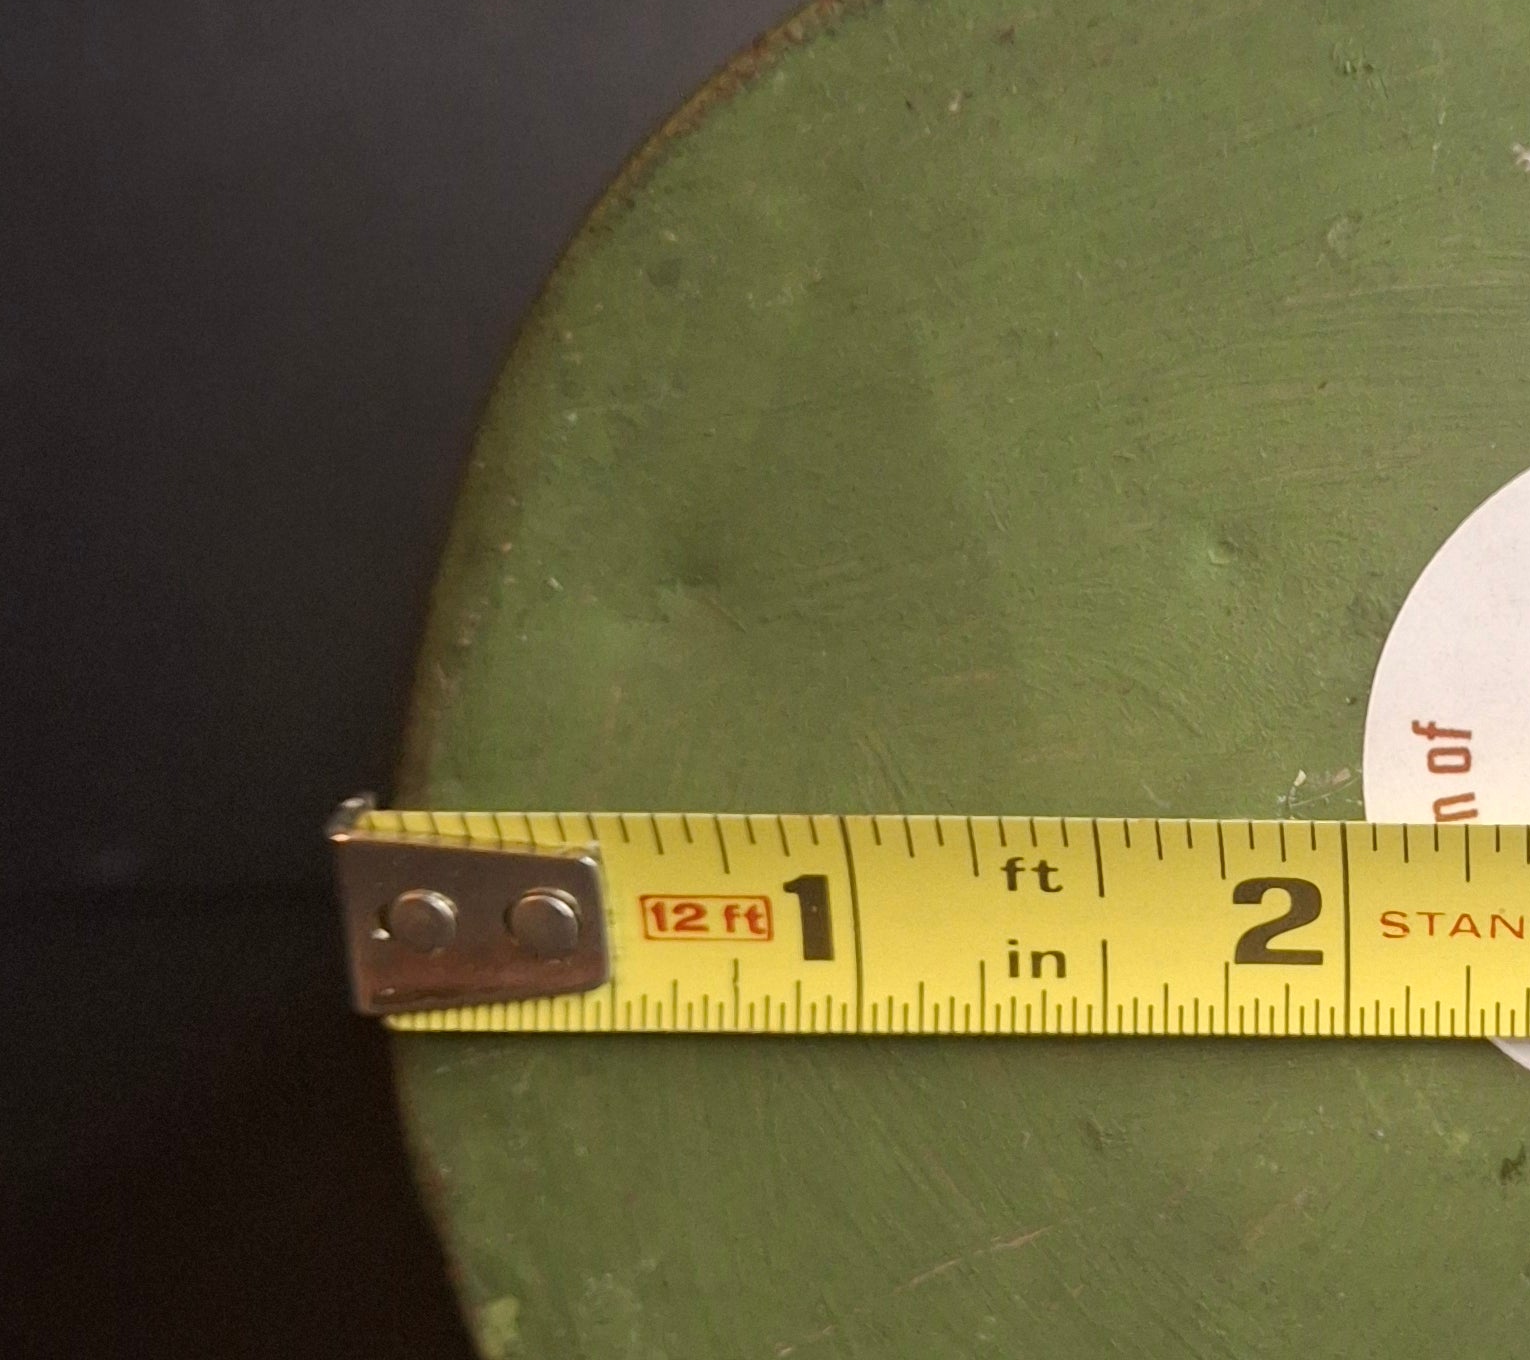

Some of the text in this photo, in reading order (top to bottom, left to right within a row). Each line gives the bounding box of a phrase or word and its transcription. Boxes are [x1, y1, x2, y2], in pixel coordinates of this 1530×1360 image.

[1410, 719, 1473, 775] of
[1000, 856, 1064, 893] ft
[649, 899, 766, 935] 12 ft
[782, 874, 835, 962] 1
[1231, 876, 1324, 966] 2
[1008, 939, 1067, 979] in
